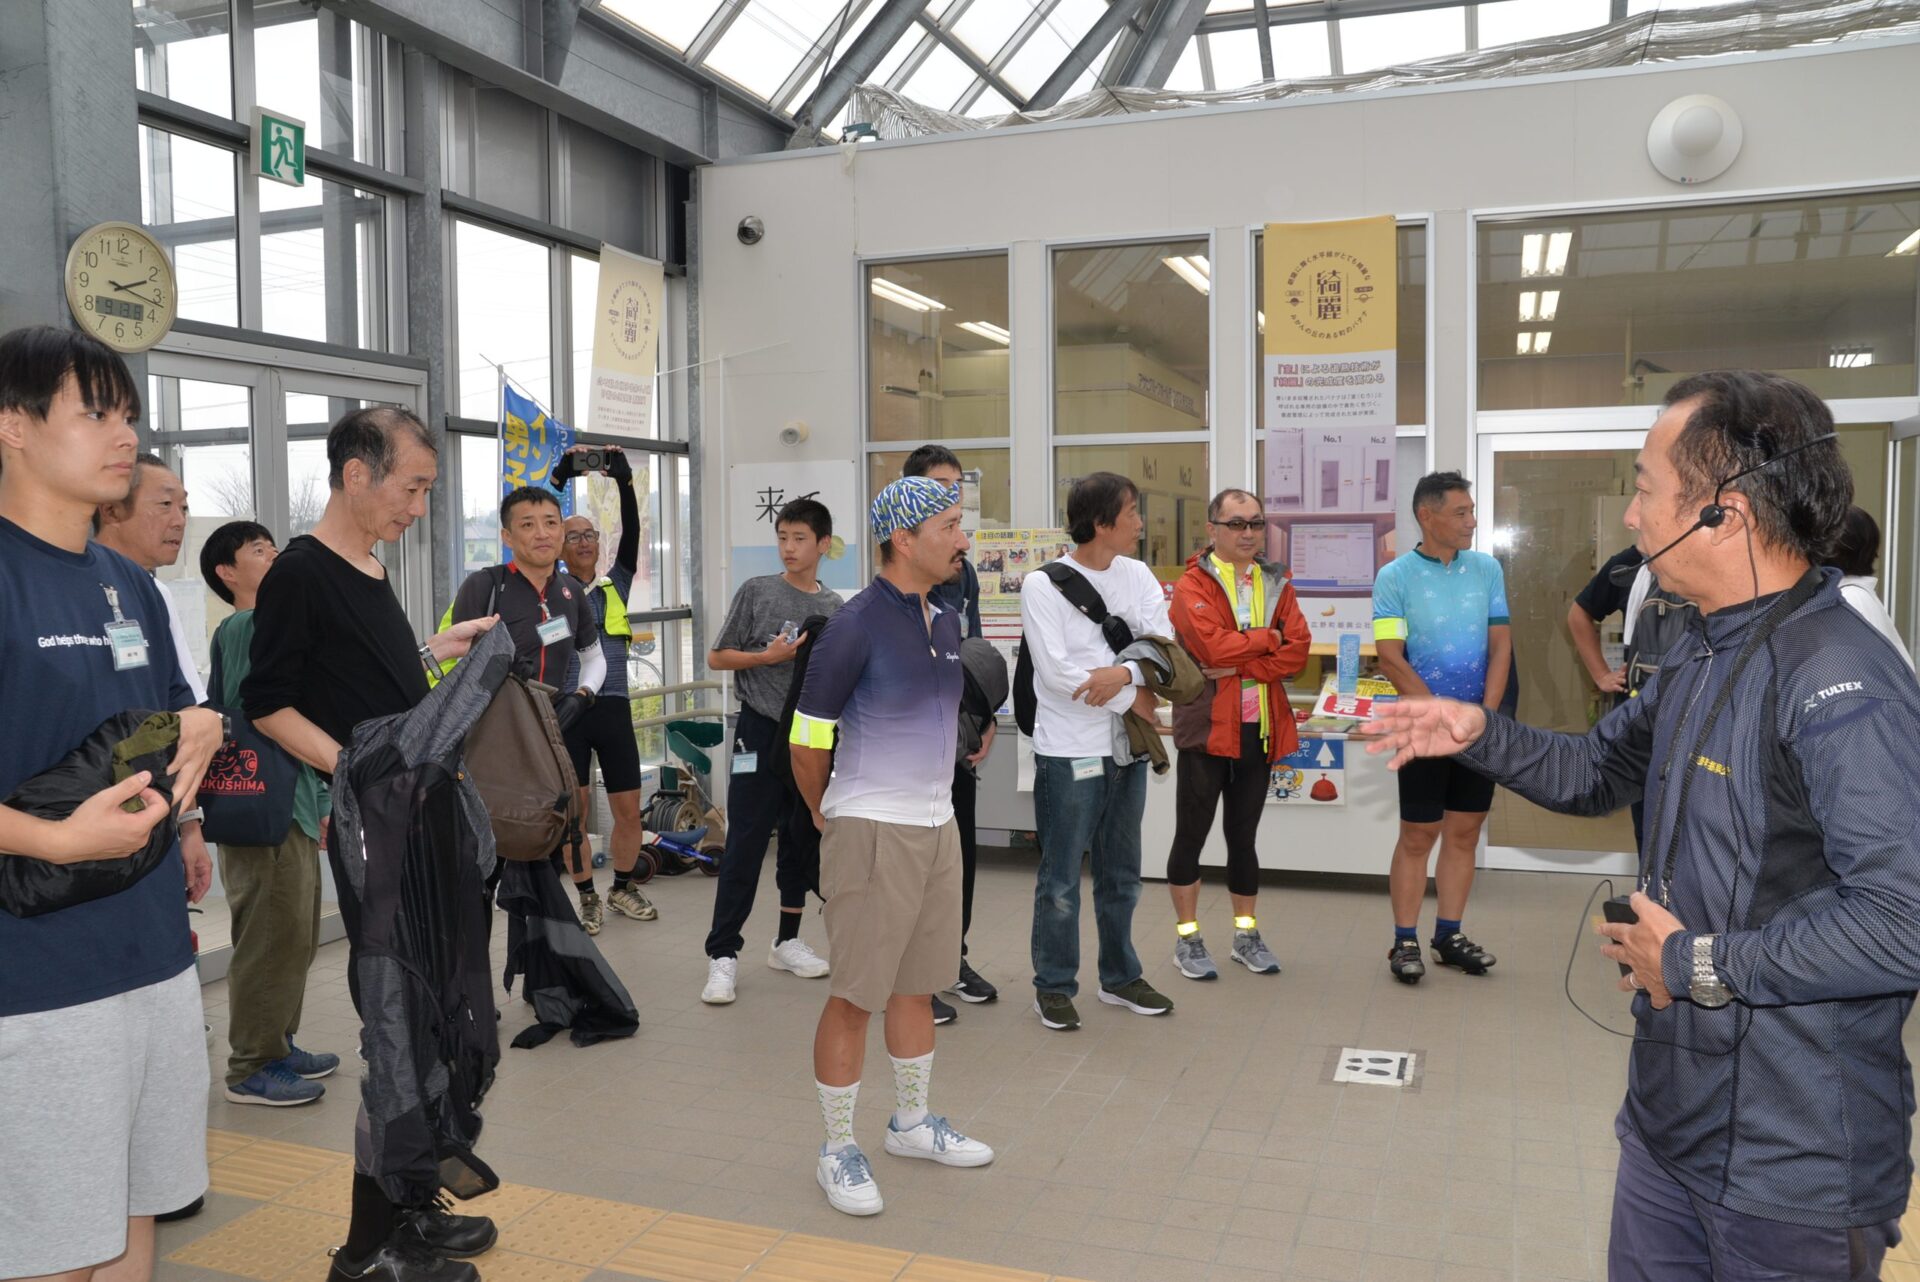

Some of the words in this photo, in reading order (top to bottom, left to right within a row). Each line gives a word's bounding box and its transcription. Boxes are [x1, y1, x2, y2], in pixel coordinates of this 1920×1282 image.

[100, 239, 111, 256] 11
[117, 239, 130, 255] 12
[85, 252, 98, 268] 10
[138, 249, 143, 263] 1
[79, 272, 89, 287] 9
[149, 266, 158, 282] 2
[84, 295, 94, 311] 8
[152, 288, 162, 304] 3
[97, 315, 106, 331] 7
[147, 309, 155, 323] 4
[115, 322, 124, 338] 6
[134, 322, 143, 336] 5
[1323, 434, 1342, 444] No.1
[38, 636, 56, 648] God
[1817, 681, 1864, 700] TULTEX
[200, 780, 266, 792] UKUSHIMA
